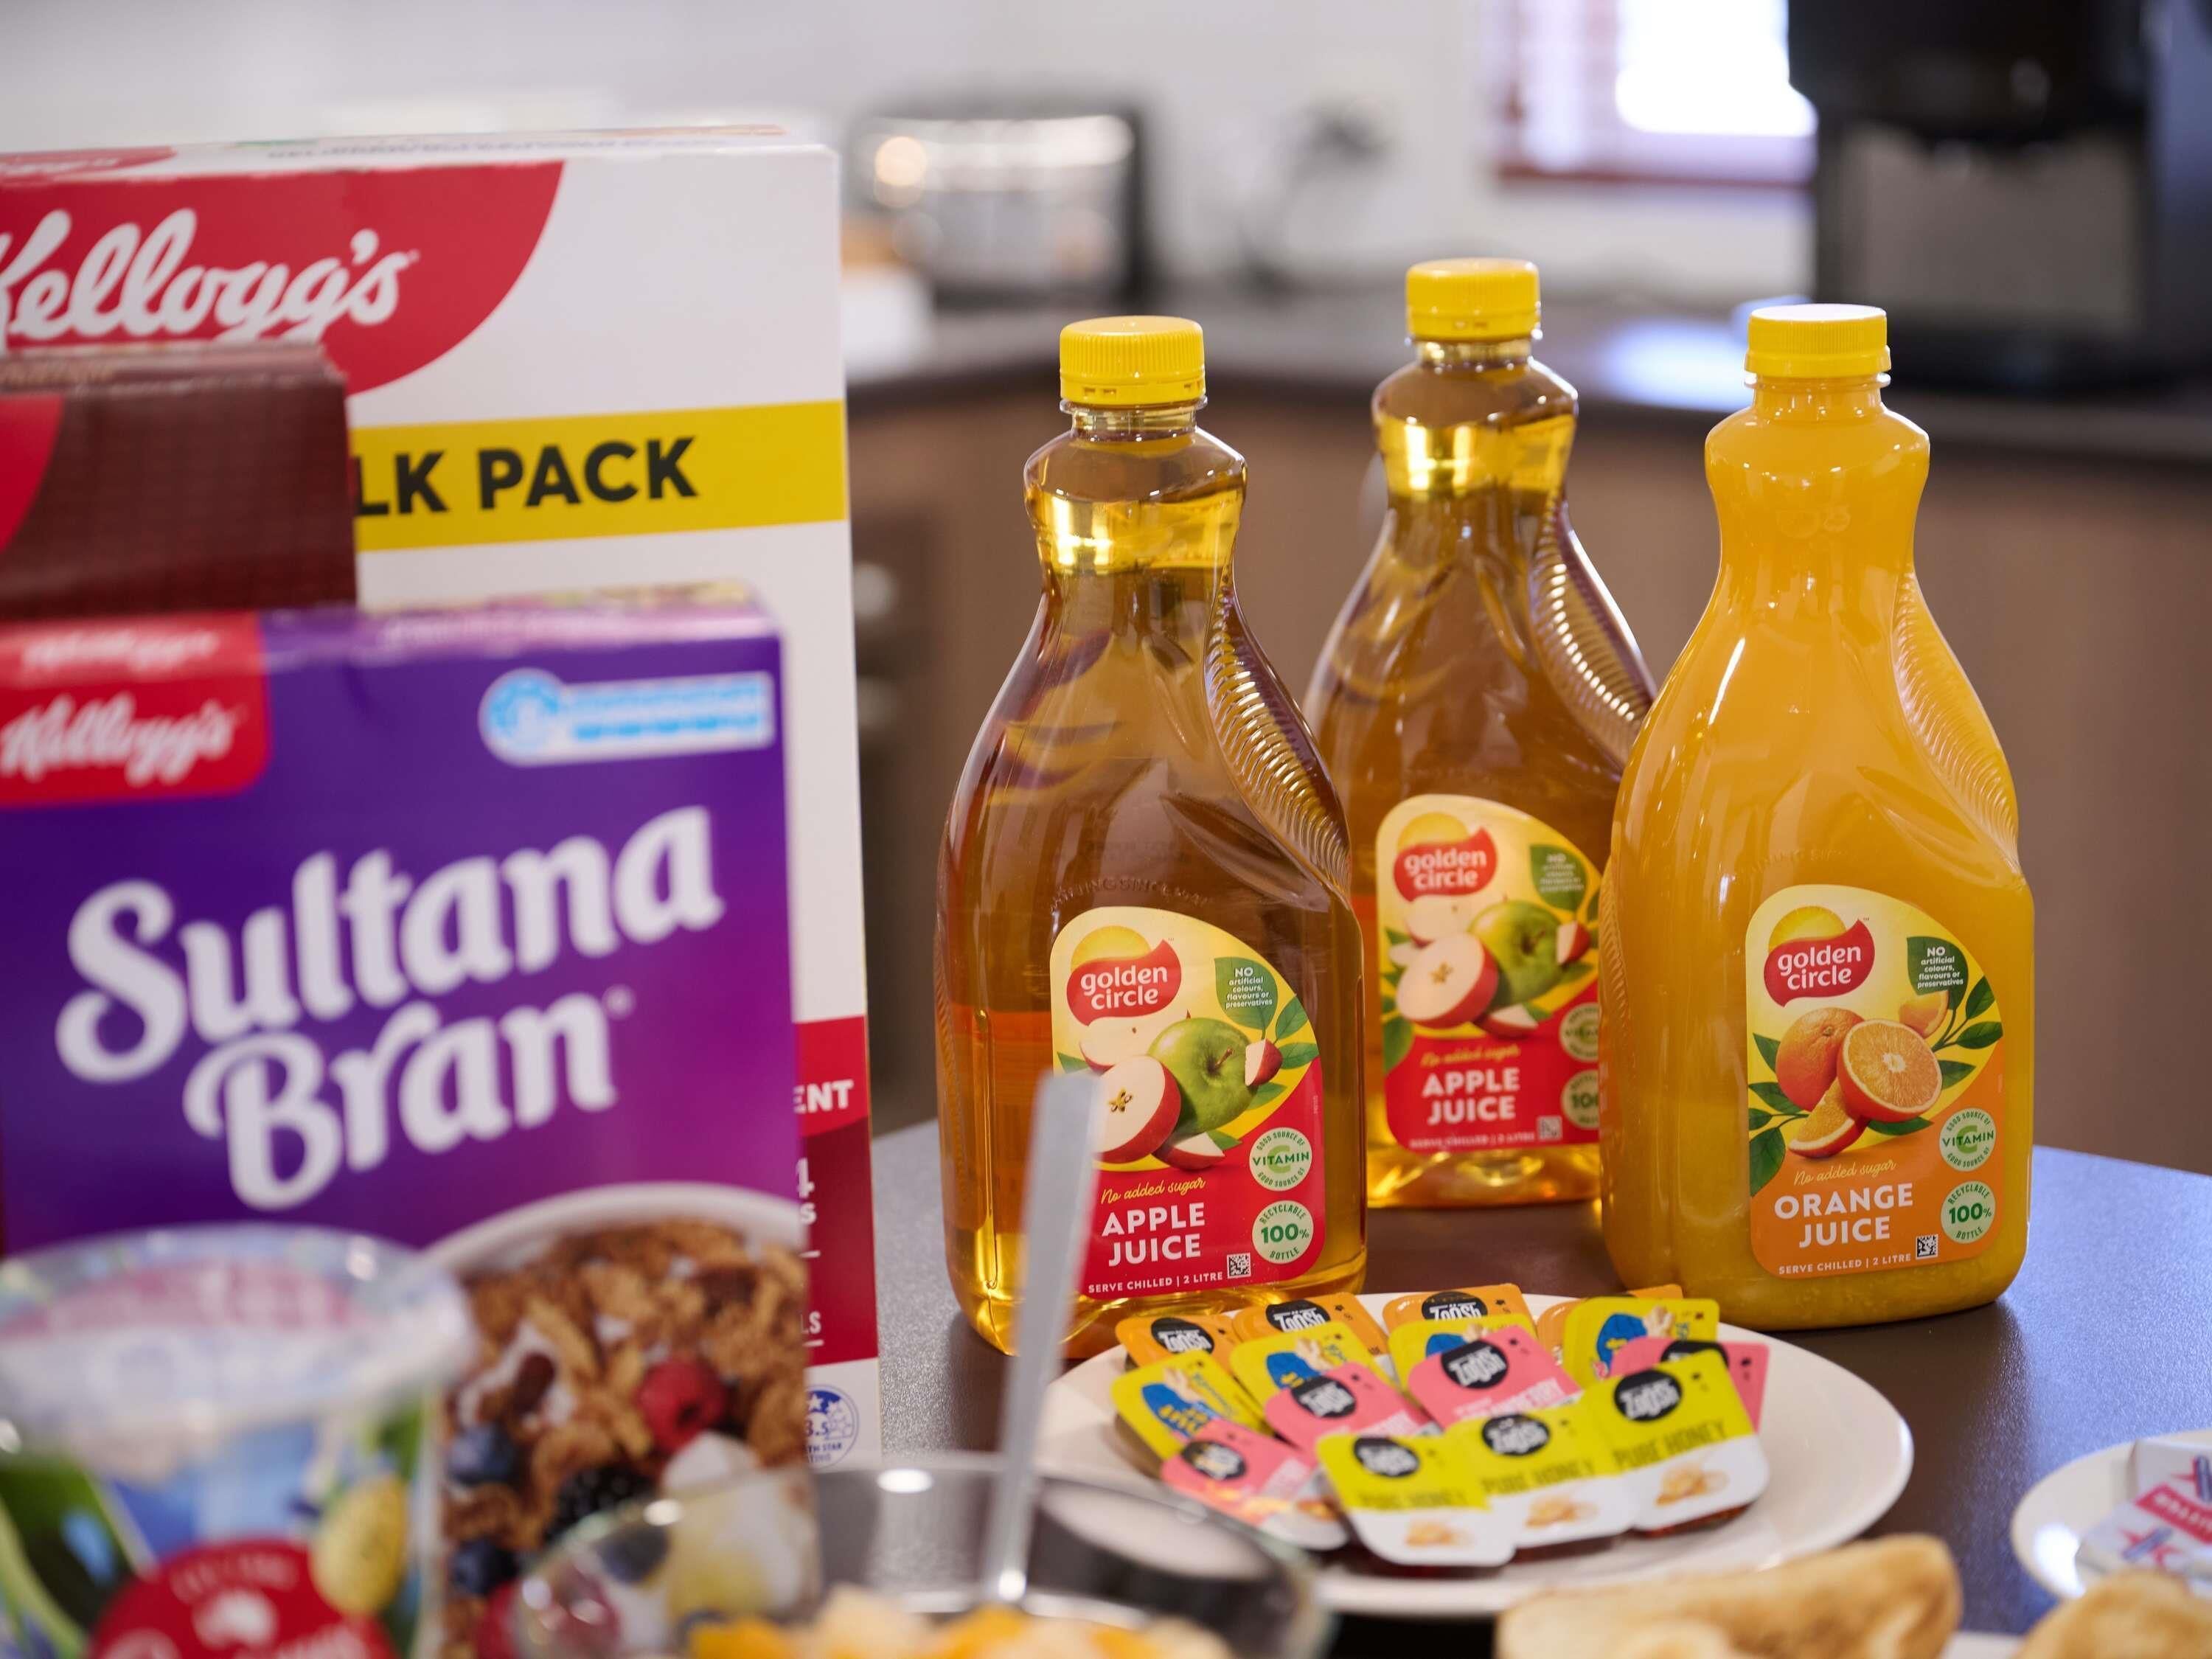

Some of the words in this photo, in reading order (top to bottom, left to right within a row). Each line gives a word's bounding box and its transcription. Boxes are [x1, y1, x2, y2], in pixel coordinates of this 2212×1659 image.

[478, 435, 699, 510] PACK
[1404, 848, 1487, 876] golden
[1413, 868, 1478, 891] circle
[55, 804, 725, 1082] Sultana
[1927, 946, 1946, 957] NO
[1778, 944, 1862, 976] golden
[1921, 956, 1955, 965] artificial
[1924, 964, 1955, 973] colours,
[1080, 965, 1168, 996] golden
[1228, 975, 1263, 986] artificial
[1234, 966, 1253, 978] NO
[1787, 964, 1852, 990] circle
[1919, 972, 1951, 981] flavours
[1232, 984, 1263, 993] colours,
[1917, 978, 1964, 990] preservatives
[1091, 987, 1158, 1011] circle
[1225, 998, 1273, 1009] preservatives
[1226, 992, 1260, 1001] flavours
[1422, 1066, 1521, 1098] APPLE
[181, 1001, 618, 1211] Bran
[1427, 1095, 1517, 1126] JUICE
[1942, 1130, 1994, 1147] VITAMIN
[1253, 1151, 1310, 1166] VITAMIN
[1794, 1170, 1814, 1186] No
[1816, 1162, 1857, 1181] added
[1860, 1159, 1896, 1178] sugar
[1101, 1188, 1121, 1205] No
[1124, 1180, 1166, 1200] added
[1167, 1177, 1206, 1196] sugar
[1774, 1182, 1913, 1220] ORANGE
[1947, 1183, 1990, 1205] RECYCLABLE
[1101, 1202, 1206, 1237] APPLE
[1259, 1203, 1307, 1225] RECYCLABLE
[1949, 1203, 1992, 1225] 100%
[1260, 1223, 1310, 1245] 100%
[1799, 1216, 1891, 1248] JUICE
[1955, 1225, 1983, 1240] BOTTLE
[1108, 1233, 1201, 1267] JUICE
[1270, 1245, 1300, 1260] BOTTLE
[1778, 1263, 1814, 1275] SERVE
[1817, 1259, 1863, 1272] CHILLED
[1872, 1256, 1879, 1266] 2
[1882, 1253, 1912, 1265] LITRE
[1088, 1281, 1124, 1294] SERVE
[1127, 1277, 1173, 1290] CHILLED
[1183, 1275, 1190, 1284] 2
[1193, 1271, 1223, 1284] LITRE
